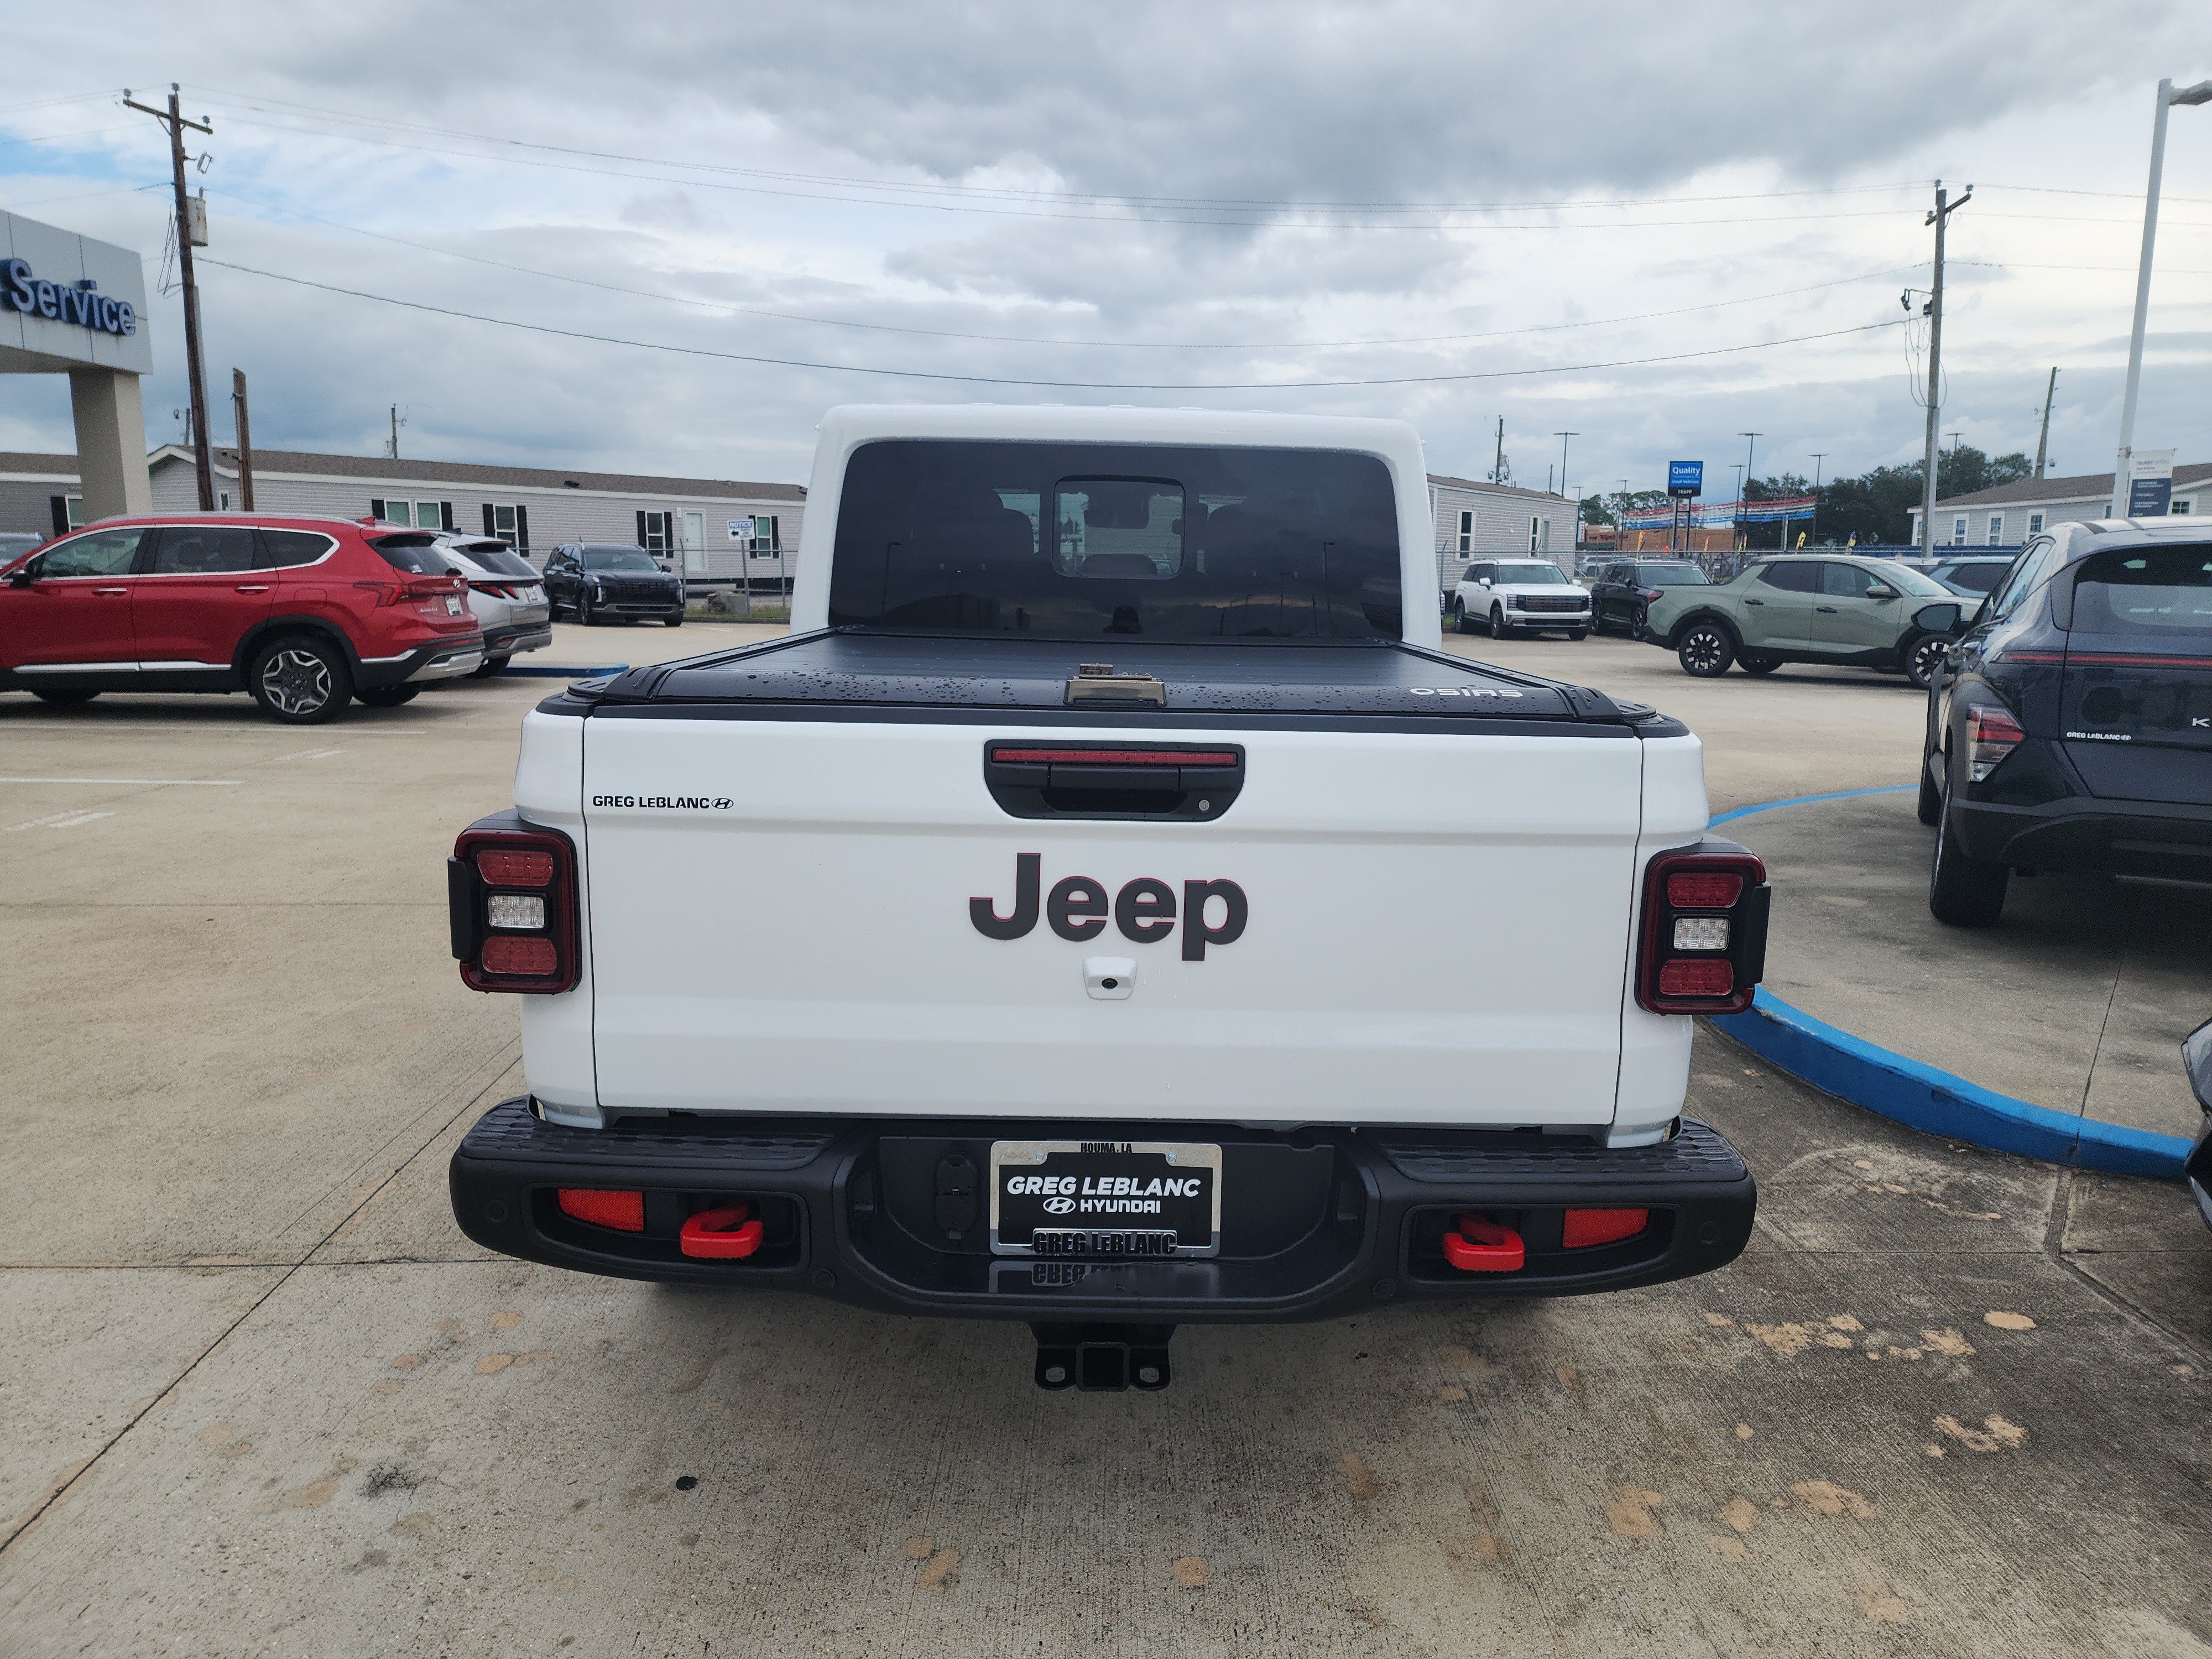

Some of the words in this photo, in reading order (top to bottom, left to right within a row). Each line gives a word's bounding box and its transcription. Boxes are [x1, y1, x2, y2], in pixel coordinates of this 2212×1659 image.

[10, 257, 136, 336] Service
[1672, 467, 1700, 476] Quality
[1410, 688, 1524, 697] OSIAS
[2192, 718, 2210, 727] K
[593, 795, 634, 807] GREG
[969, 852, 1248, 961] Jeep
[1121, 1142, 1133, 1154] LA
[1007, 1176, 1077, 1194] GREG
[1082, 1177, 1201, 1197] LEBLANC
[1080, 1199, 1161, 1213] HYUNDAI
[1034, 1232, 1087, 1254] GREG
